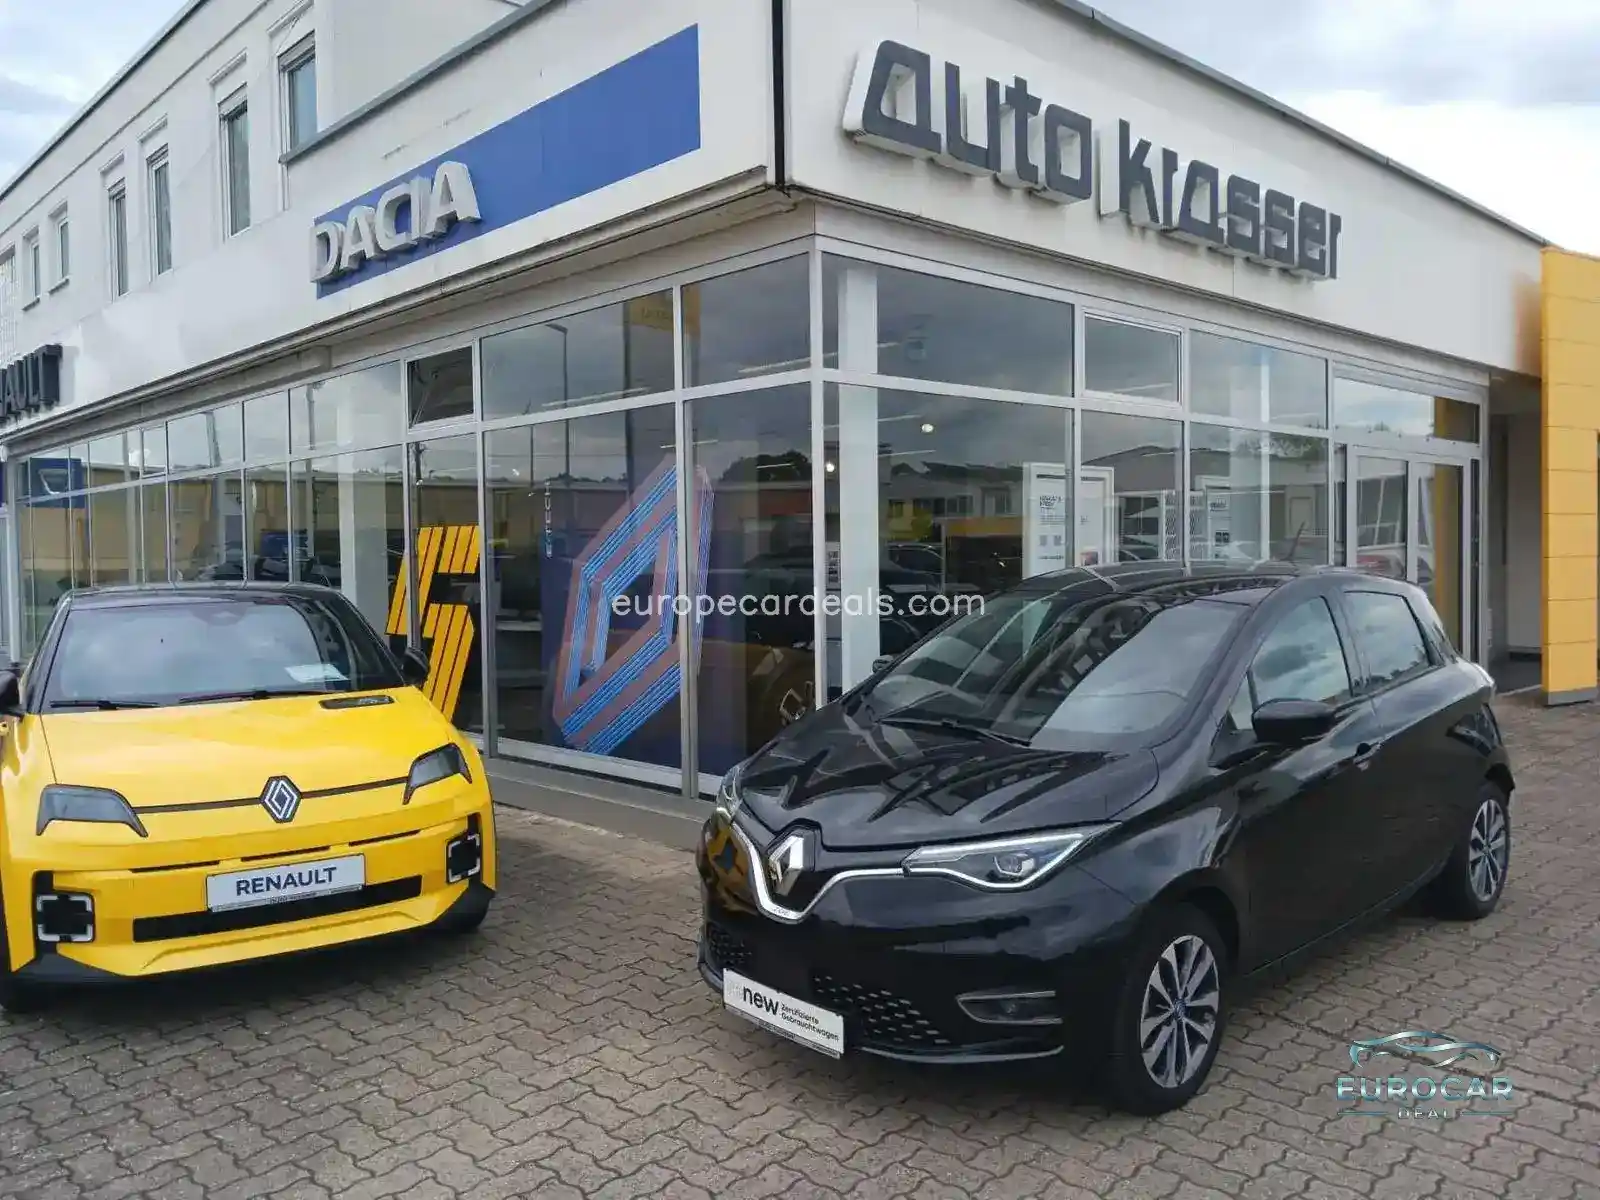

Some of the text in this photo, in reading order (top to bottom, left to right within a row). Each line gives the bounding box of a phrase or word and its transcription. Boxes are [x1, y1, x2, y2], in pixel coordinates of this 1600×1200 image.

[309, 160, 482, 284] DACIA
[235, 866, 337, 897] RENAULT
[742, 985, 780, 1017] new
